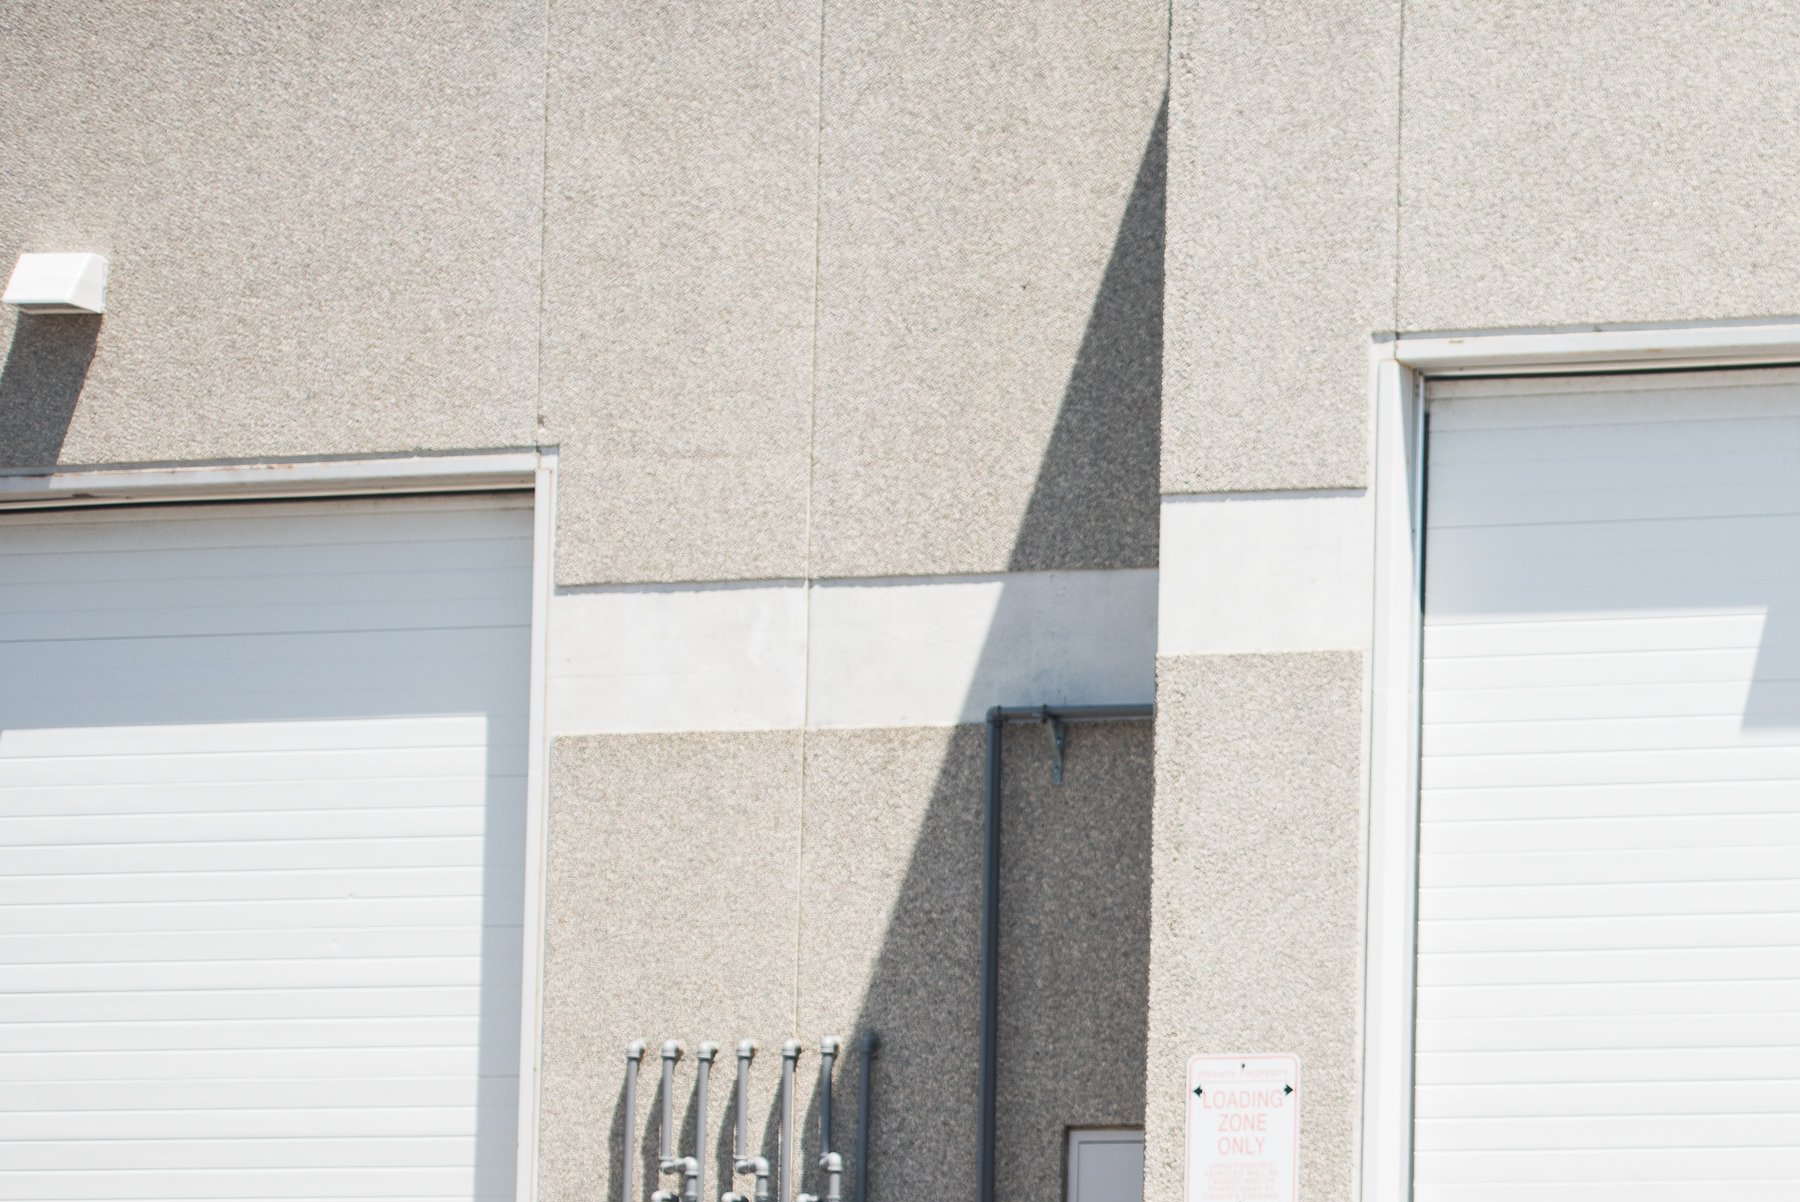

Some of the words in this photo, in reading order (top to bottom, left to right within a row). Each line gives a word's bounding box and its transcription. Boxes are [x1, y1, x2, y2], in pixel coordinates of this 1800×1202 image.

[1203, 1090, 1283, 1109] LOADING
[1218, 1113, 1267, 1132] ZONE
[1218, 1136, 1265, 1155] ONLY
